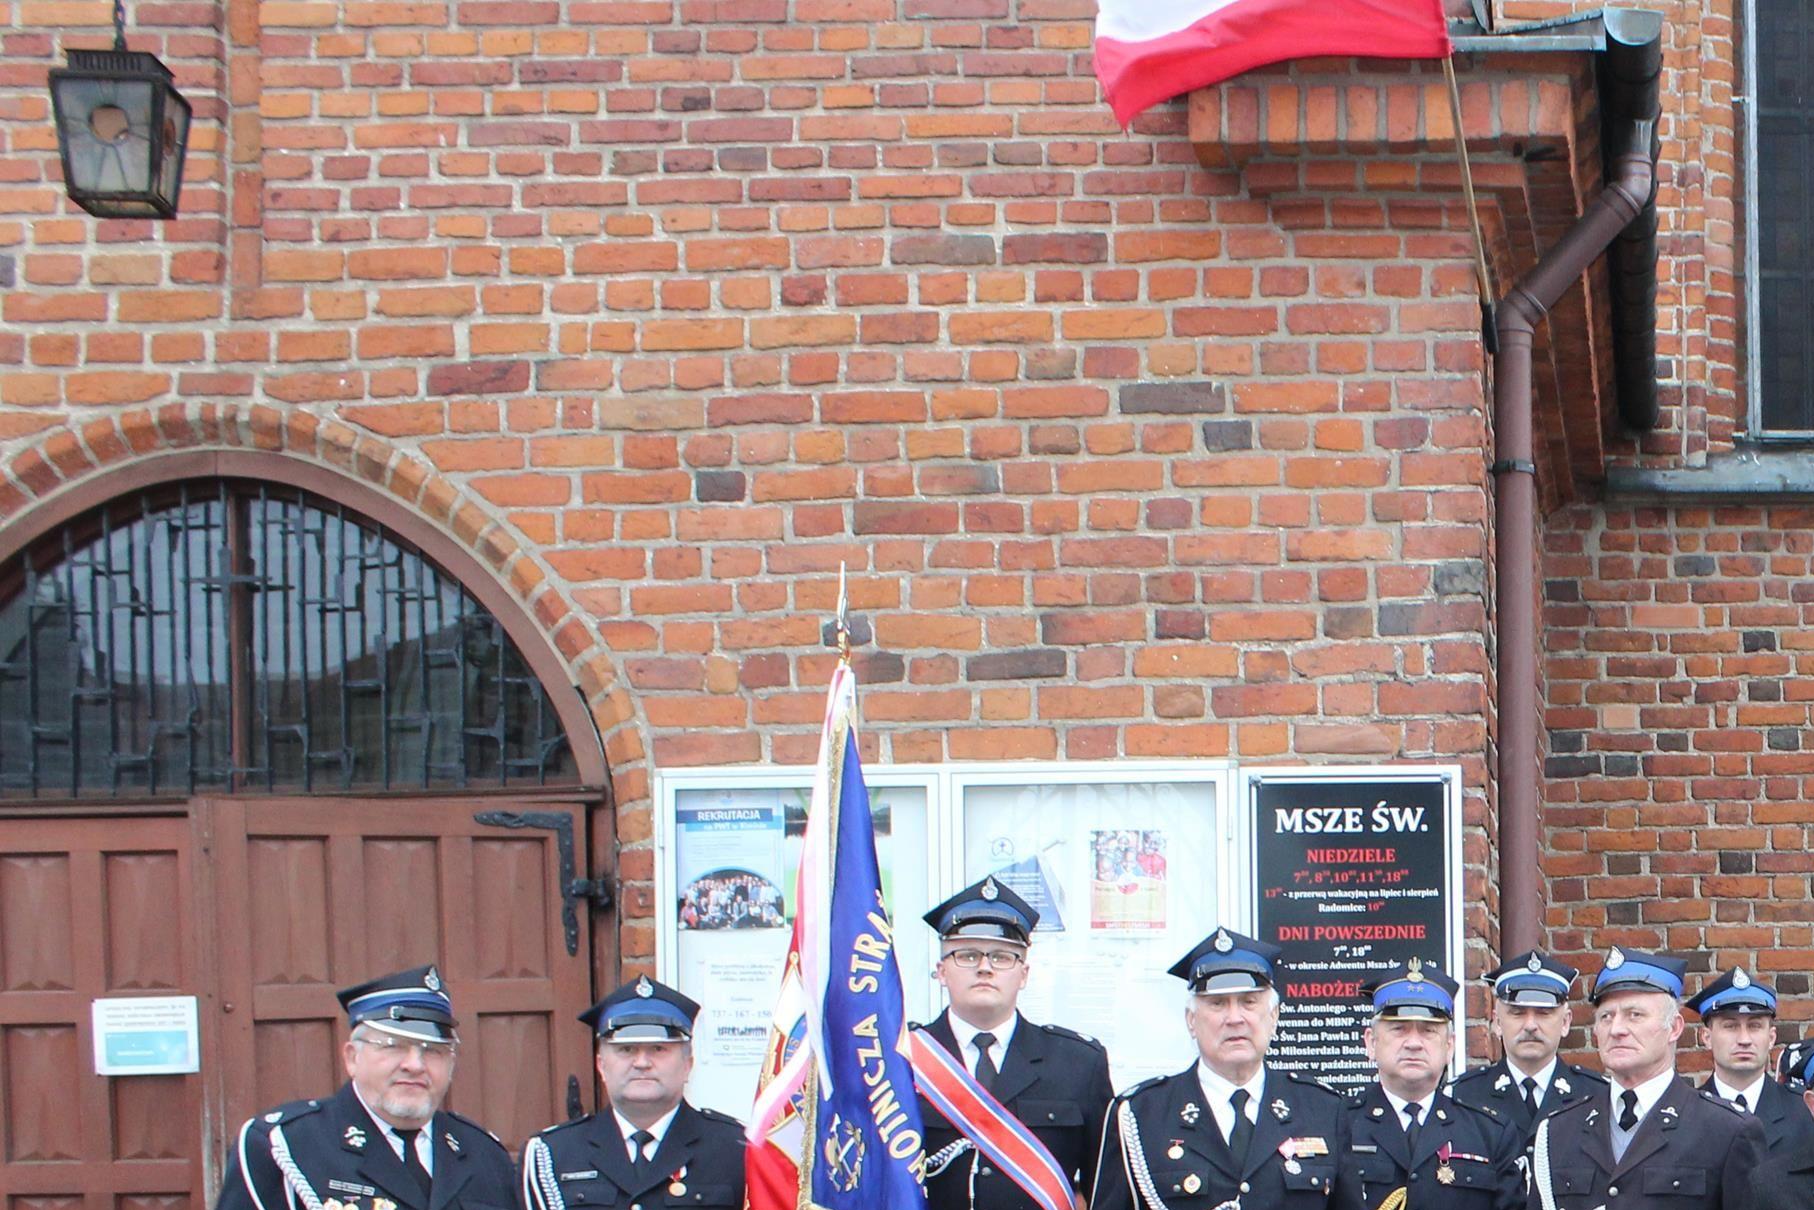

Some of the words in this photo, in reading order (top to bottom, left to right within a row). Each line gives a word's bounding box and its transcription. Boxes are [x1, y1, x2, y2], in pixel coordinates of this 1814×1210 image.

[697, 810, 761, 821] REKRUTACJA
[1275, 808, 1363, 833] MSZE
[1372, 801, 1428, 832] ŚW.
[1307, 848, 1395, 863] NIEDZIELE
[1295, 890, 1325, 899] przerwą
[1328, 889, 1368, 899] wakacyjną
[1369, 890, 1379, 898] na
[1407, 888, 1438, 898] sierpień
[1319, 903, 1366, 912] Radomice:
[1279, 926, 1309, 940] DNI
[1314, 925, 1425, 940] POWSZEDNIE
[1298, 961, 1329, 970] okresie
[1330, 961, 1366, 969] Adwentu
[1367, 961, 1387, 969] Msza
[1299, 1005, 1346, 1014] Antoniego
[1311, 1018, 1323, 1027] do
[1325, 1018, 1355, 1027] MBNP
[1280, 1031, 1296, 1041] Św.
[1298, 1032, 1319, 1043] Jana
[1321, 1031, 1347, 1041] Pawła
[1281, 1046, 1340, 1056] Miłosierdzia
[1310, 1062, 1319, 1070] w
